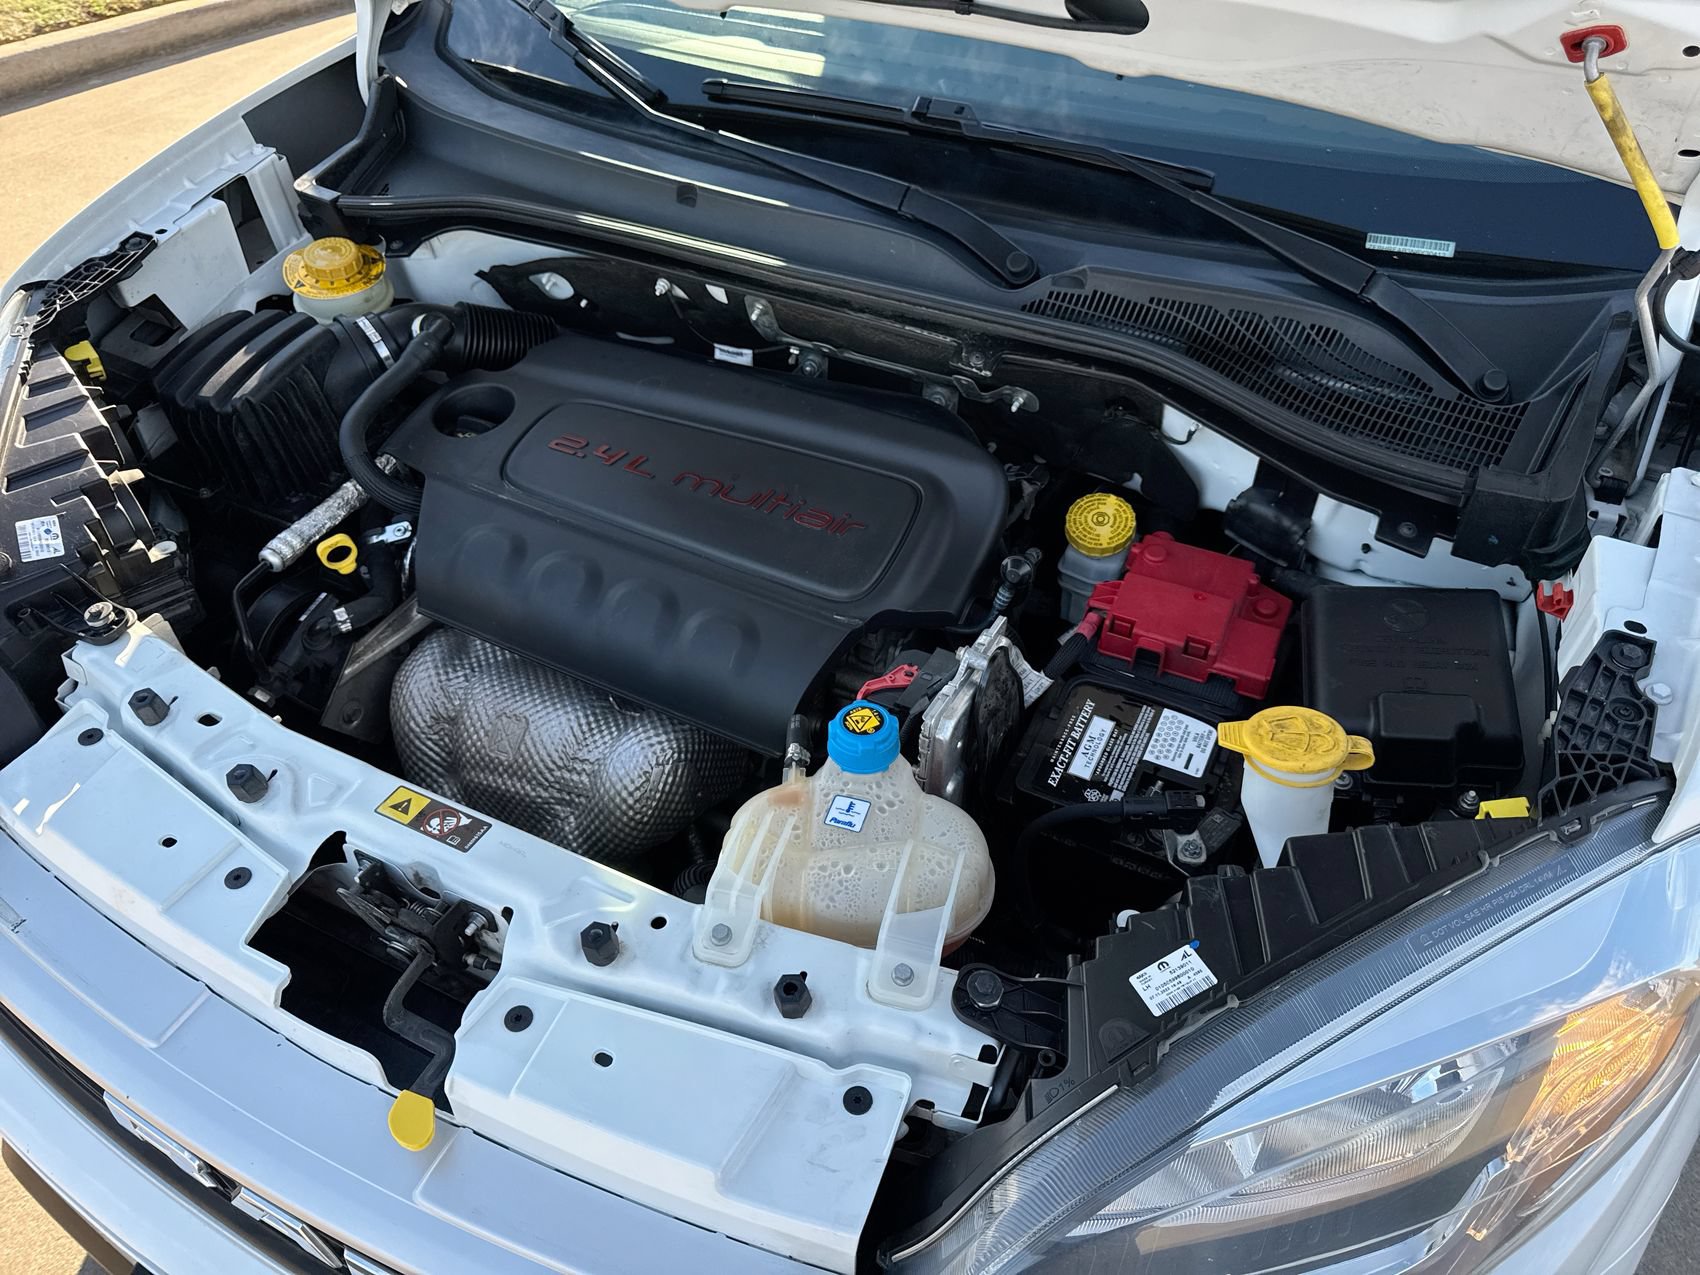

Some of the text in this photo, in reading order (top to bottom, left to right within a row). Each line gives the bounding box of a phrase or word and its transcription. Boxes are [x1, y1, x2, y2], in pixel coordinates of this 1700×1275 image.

[671, 471, 865, 537] multiair
[1047, 698, 1096, 787] EXACT-FIT BATTERY
[1083, 728, 1107, 769] TECHNOLOGY
[1432, 924, 1449, 938] DOT
[1464, 908, 1481, 921] SAE
[1480, 901, 1495, 913] HR
